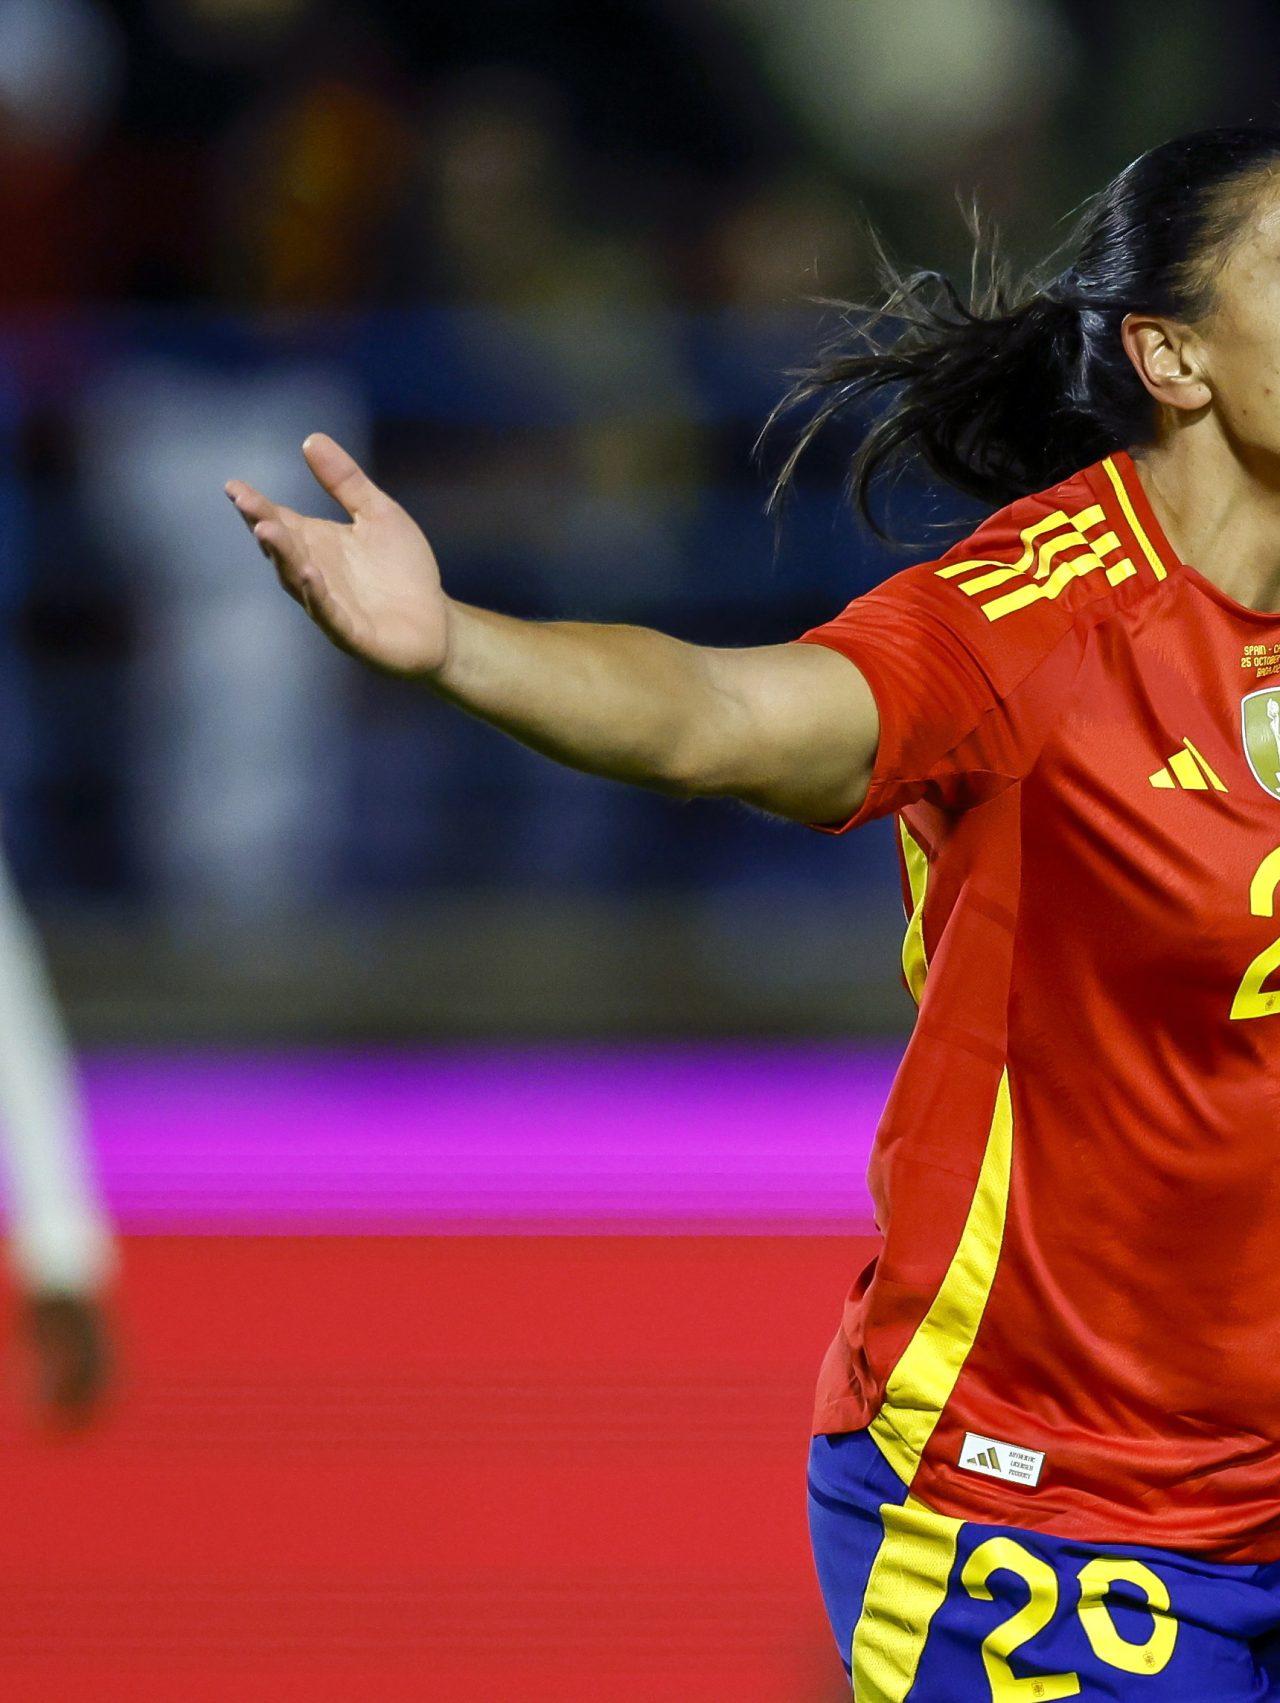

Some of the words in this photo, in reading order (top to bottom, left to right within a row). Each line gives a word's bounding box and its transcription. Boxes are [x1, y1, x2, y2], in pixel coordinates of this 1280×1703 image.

[1243, 645, 1266, 656] SPAIN
[1241, 657, 1252, 668] 25
[961, 1537, 1178, 1703] 20
